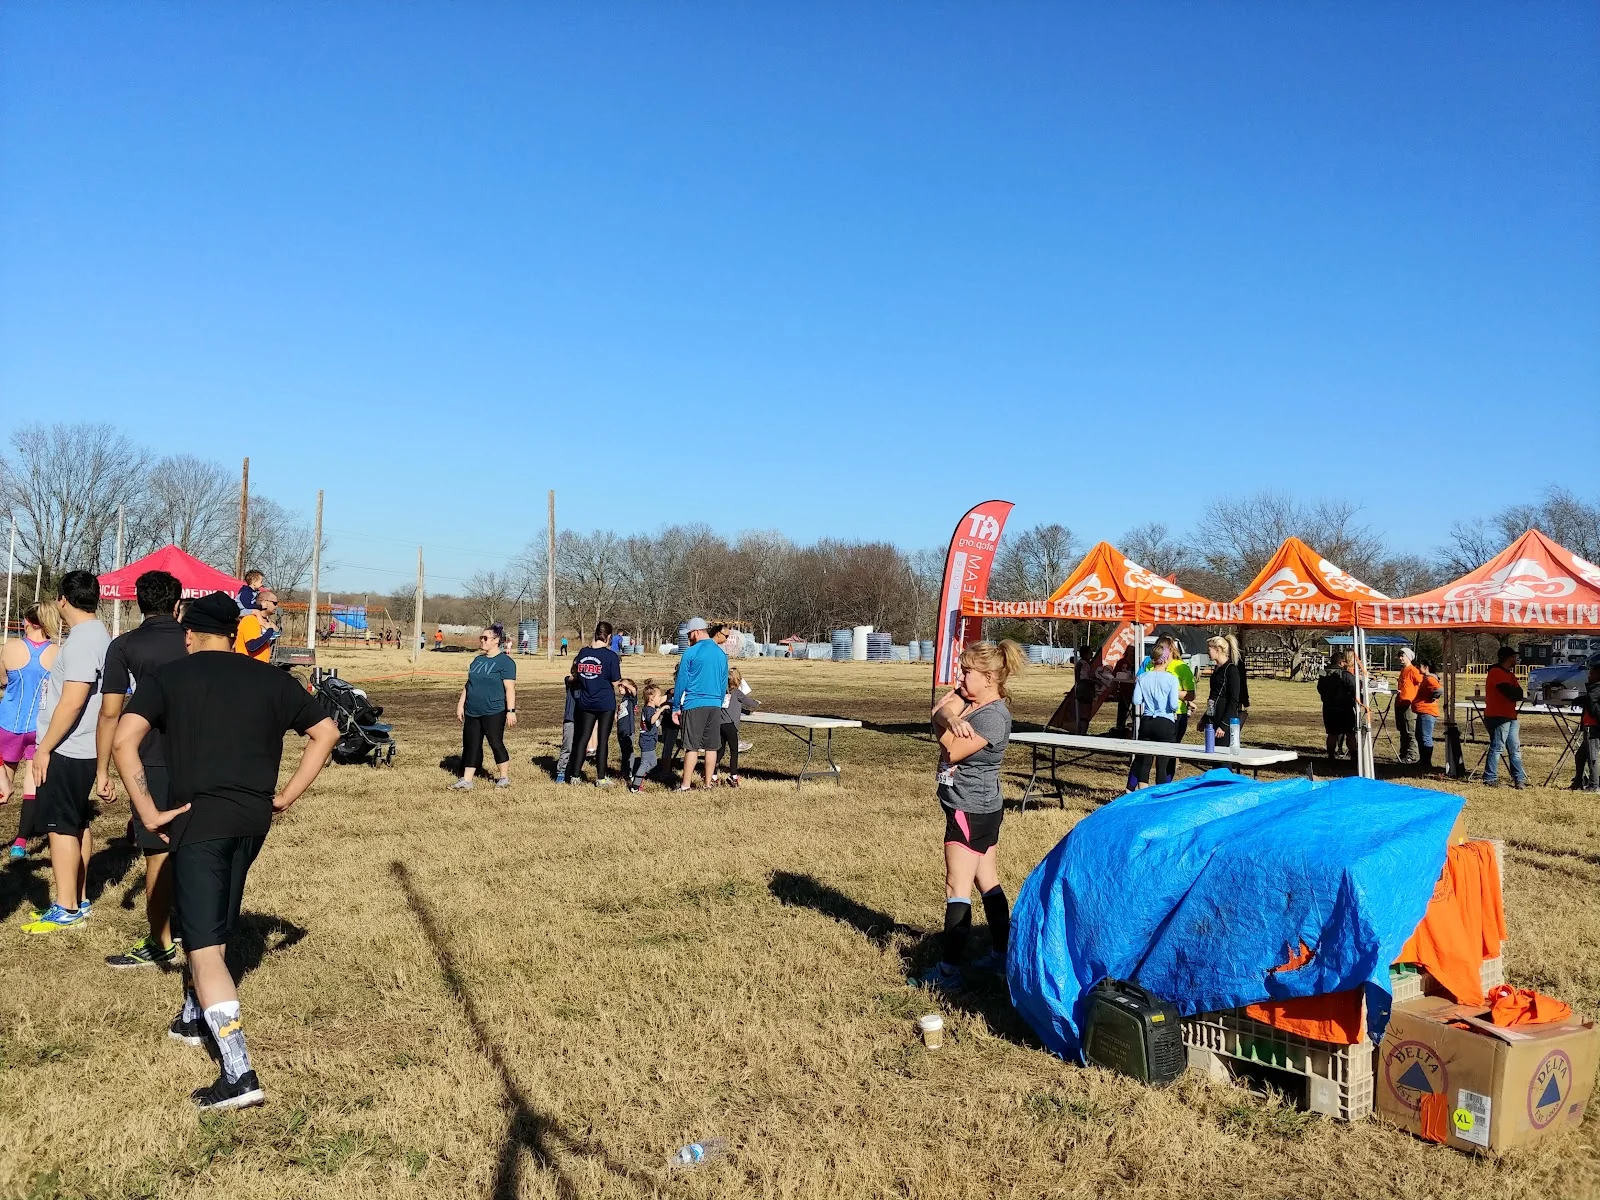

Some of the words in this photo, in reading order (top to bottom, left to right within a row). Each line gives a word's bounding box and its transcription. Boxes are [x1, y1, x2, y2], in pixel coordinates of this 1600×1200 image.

[972, 598, 1047, 615] TERRAIN
[1053, 600, 1124, 618] RACING
[1150, 601, 1245, 621] TERRAIN
[1252, 602, 1342, 623] RACING
[1368, 598, 1491, 625] TERRAIN
[1502, 599, 1600, 625] RACIN
[577, 663, 602, 674] FIRE
[1395, 1046, 1439, 1074] DELTA
[1537, 1057, 1568, 1085] DELTA
[1456, 1113, 1471, 1124] XL
